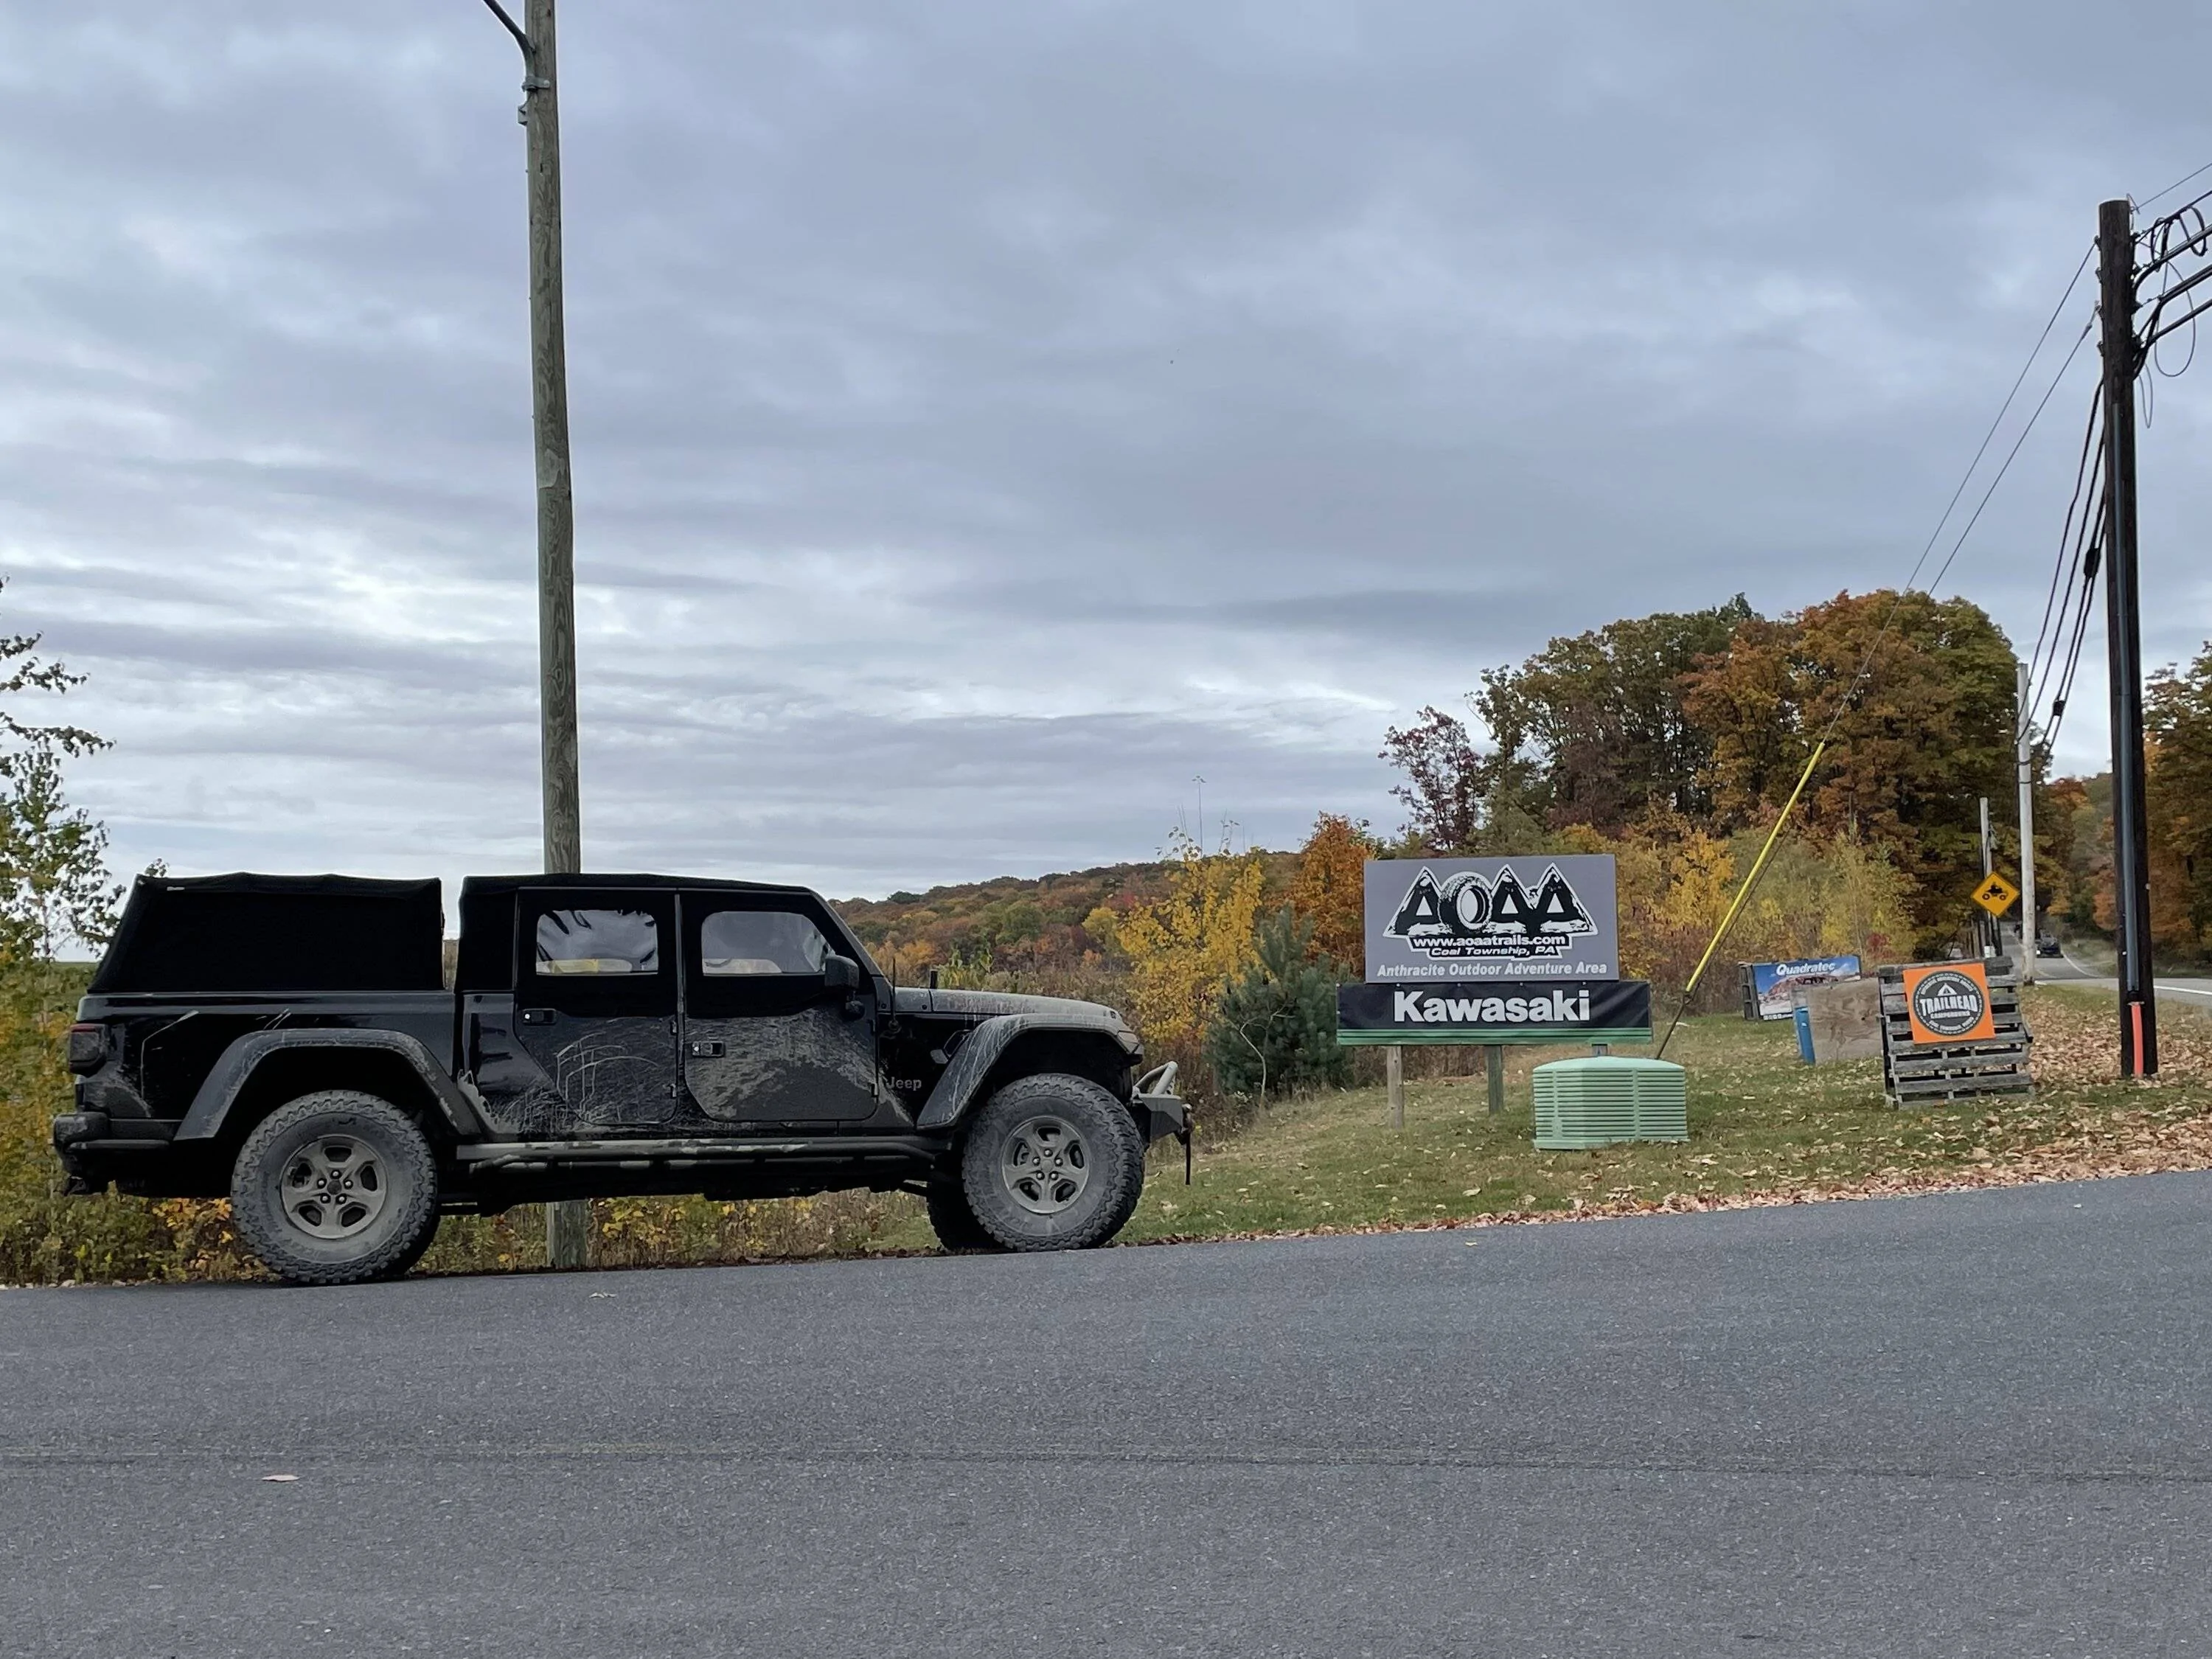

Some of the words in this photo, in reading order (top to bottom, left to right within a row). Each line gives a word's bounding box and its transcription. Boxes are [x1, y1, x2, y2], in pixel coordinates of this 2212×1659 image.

[1382, 863, 1599, 936] AOAA
[1413, 933, 1567, 947] www.aoaatrails.com
[1430, 947, 1461, 956] Coal
[1465, 945, 1531, 957] Township,
[1534, 945, 1557, 955] PA
[1377, 964, 1446, 977] Anthracite
[1449, 962, 1502, 975] Outdoor
[1504, 961, 1573, 975] Adventure
[1575, 961, 1607, 974] Area
[1776, 961, 1835, 975] Quadratec
[1394, 990, 1590, 1023] Kawasaki
[1920, 995, 1978, 1016] TRAILHEAD
[886, 1077, 922, 1091] Jeep
